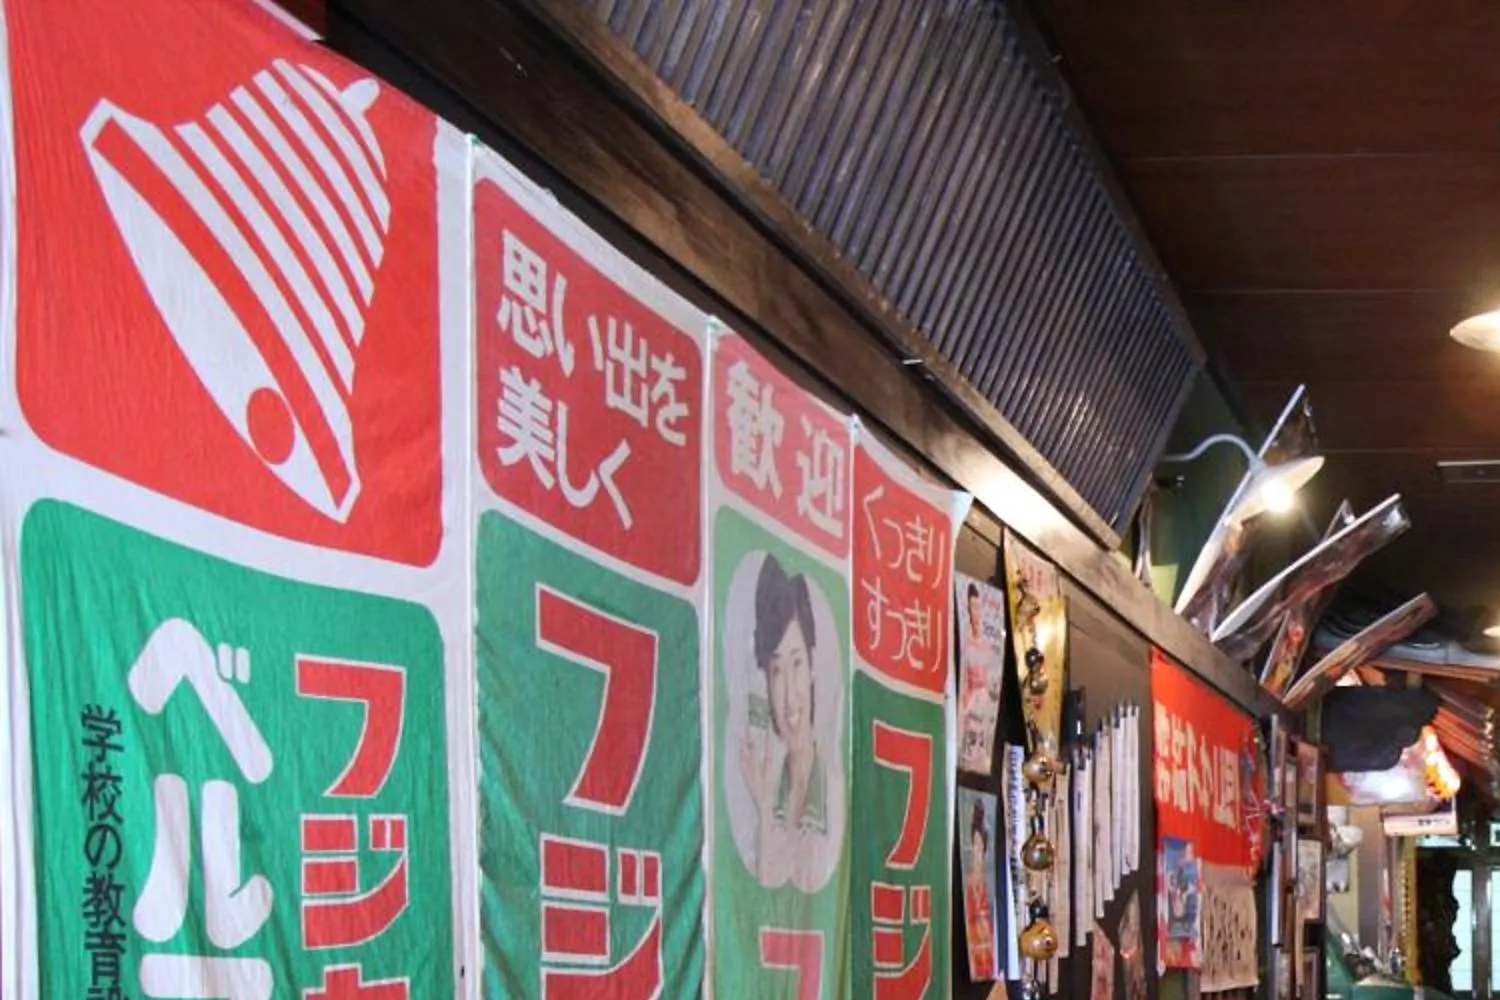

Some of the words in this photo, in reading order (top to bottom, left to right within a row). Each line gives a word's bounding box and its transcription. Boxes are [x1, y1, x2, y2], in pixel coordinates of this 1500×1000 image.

[497, 228, 690, 447] 思い出を
[497, 366, 634, 531] 美しく
